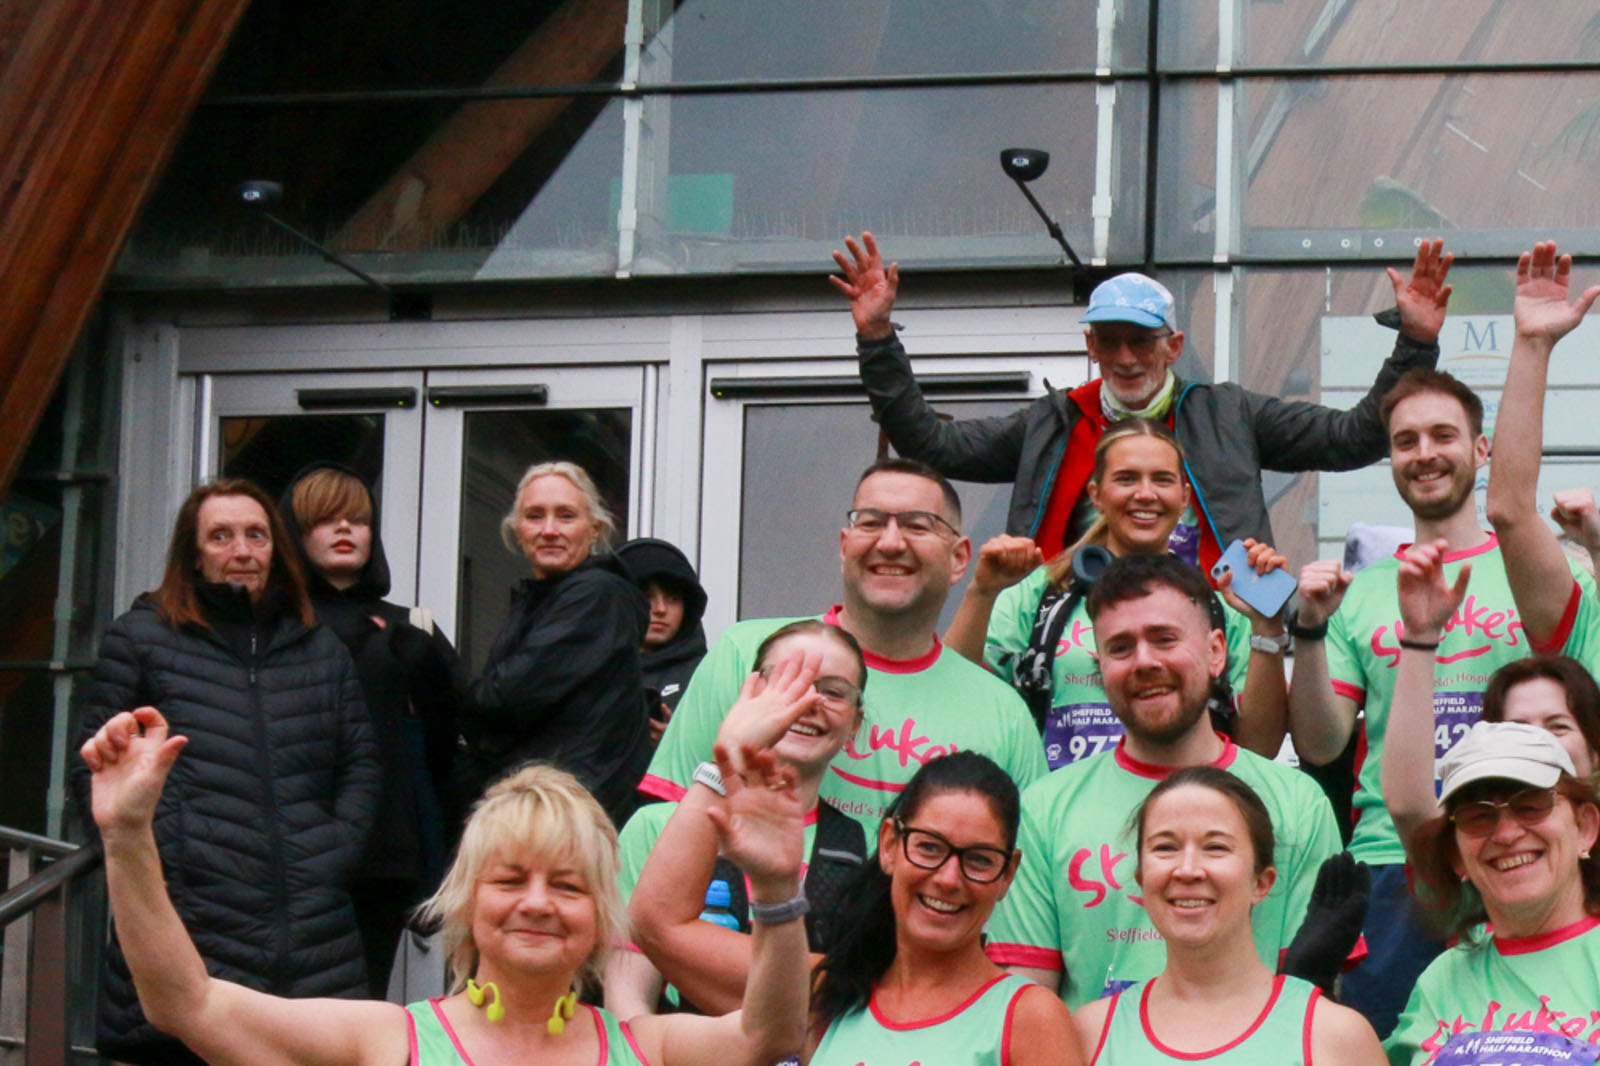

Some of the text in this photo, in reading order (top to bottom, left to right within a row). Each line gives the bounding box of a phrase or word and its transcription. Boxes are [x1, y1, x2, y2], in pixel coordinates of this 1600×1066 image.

[1463, 320, 1500, 351] M
[1072, 709, 1111, 717] SHEFFIELD
[1093, 716, 1122, 725] MARA
[1068, 843, 1128, 908] St
[1485, 1036, 1535, 1045] SHEFFIELD
[1480, 1044, 1572, 1060] HALF MARATHON
